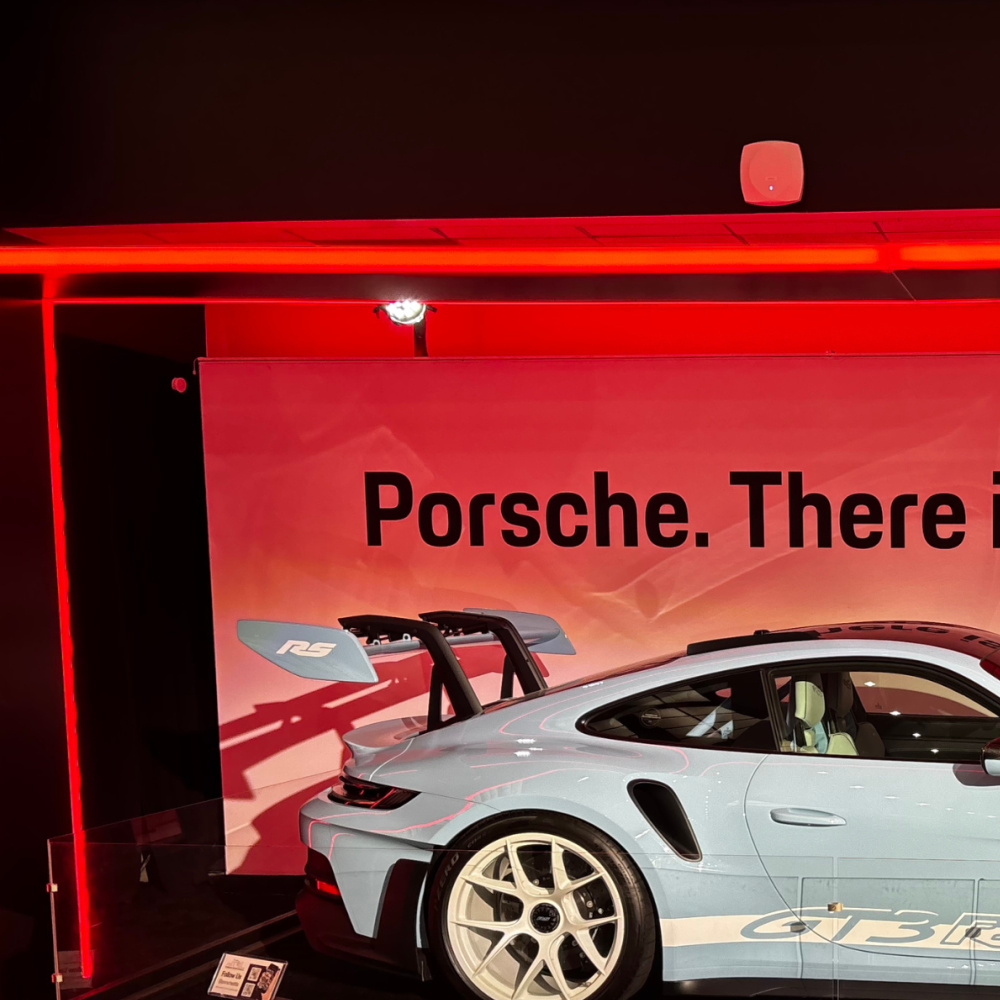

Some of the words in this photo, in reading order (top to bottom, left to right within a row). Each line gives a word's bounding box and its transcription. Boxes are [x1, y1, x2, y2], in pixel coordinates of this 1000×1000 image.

[363, 470, 710, 548] Porsche.
[729, 470, 967, 549] There
[275, 639, 337, 658] RS
